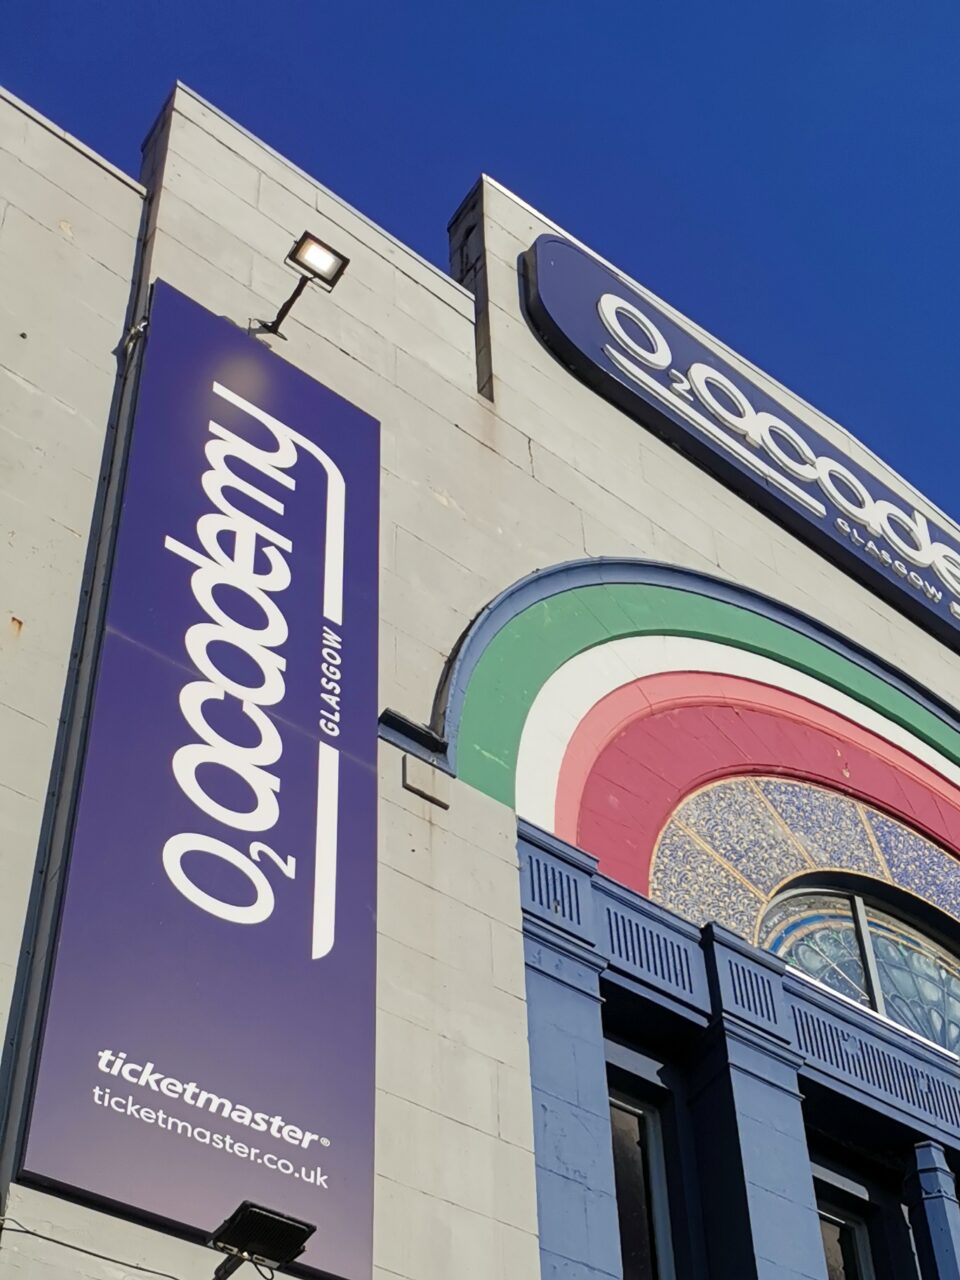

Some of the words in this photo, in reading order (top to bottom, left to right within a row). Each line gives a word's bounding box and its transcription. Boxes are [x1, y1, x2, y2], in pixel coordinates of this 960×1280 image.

[164, 381, 345, 832] academy
[833, 516, 944, 604] GLASGOW
[318, 625, 343, 739] GLASGOW
[92, 1085, 329, 1189] ticketmaster.co.uk
